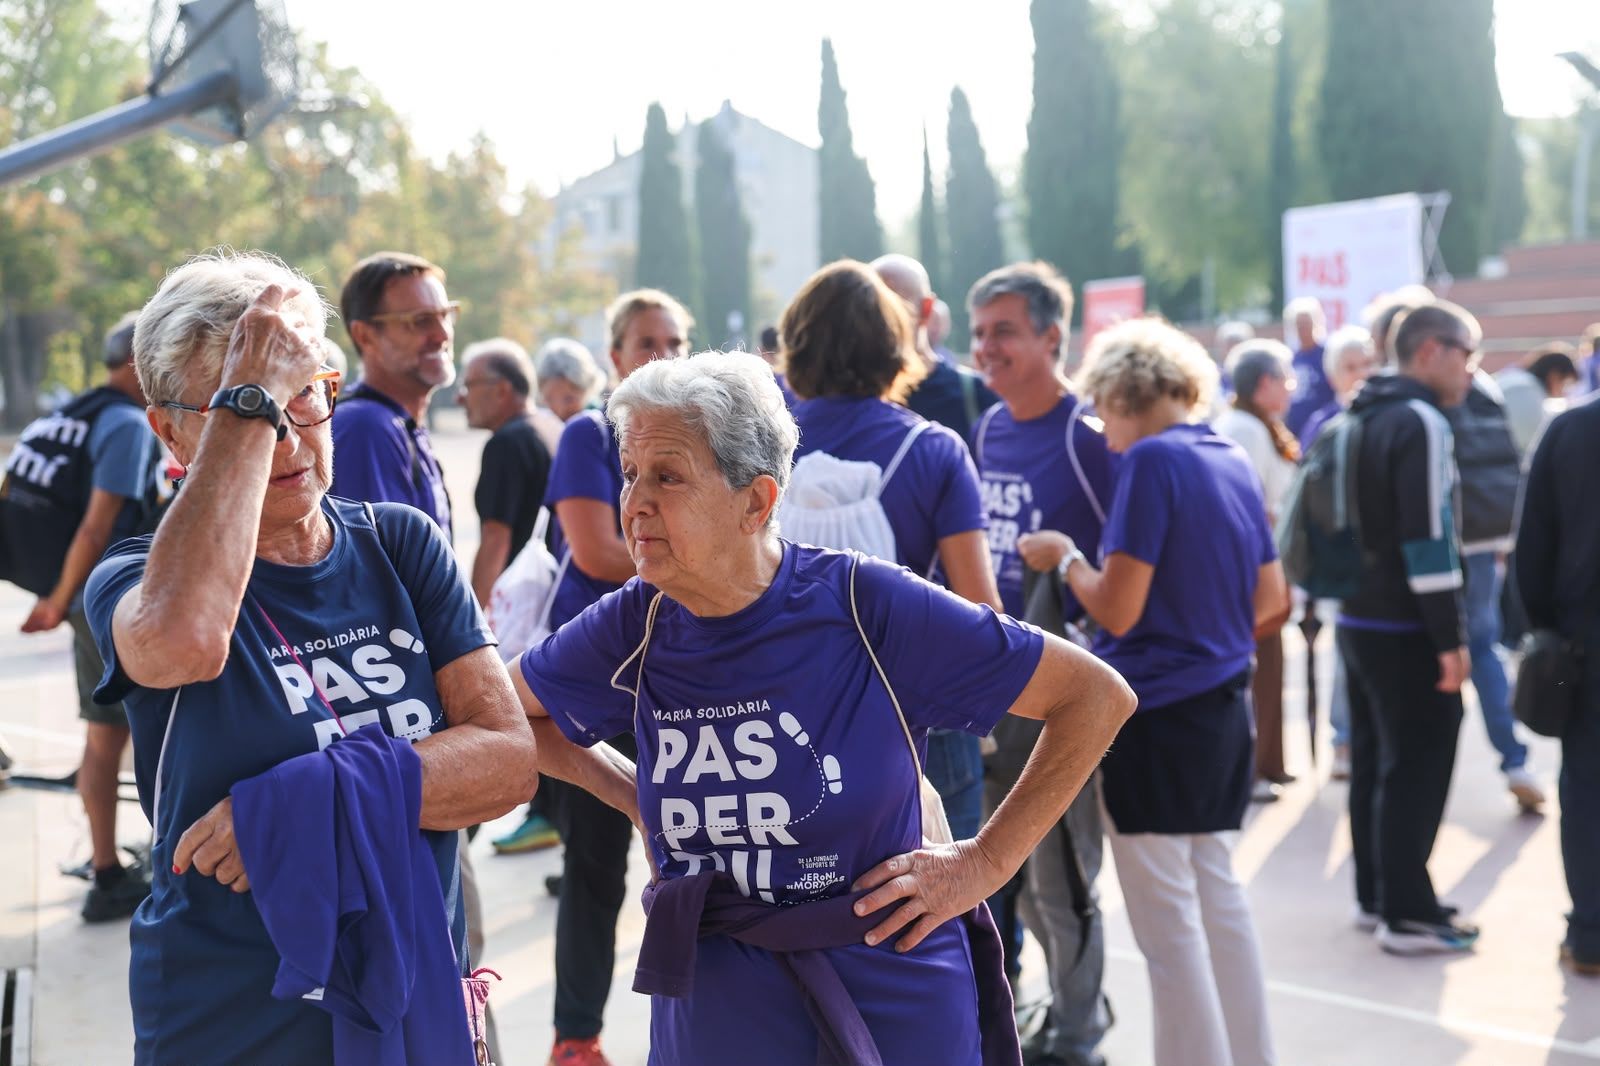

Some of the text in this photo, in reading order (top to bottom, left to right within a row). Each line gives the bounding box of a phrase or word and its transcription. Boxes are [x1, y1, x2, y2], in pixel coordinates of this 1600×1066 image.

[304, 625, 380, 653] SOLIDÀRIA
[272, 644, 406, 715] PAS
[696, 699, 771, 720] SOLIDÀRIA
[651, 719, 778, 784] PAS
[660, 791, 800, 852] PER
